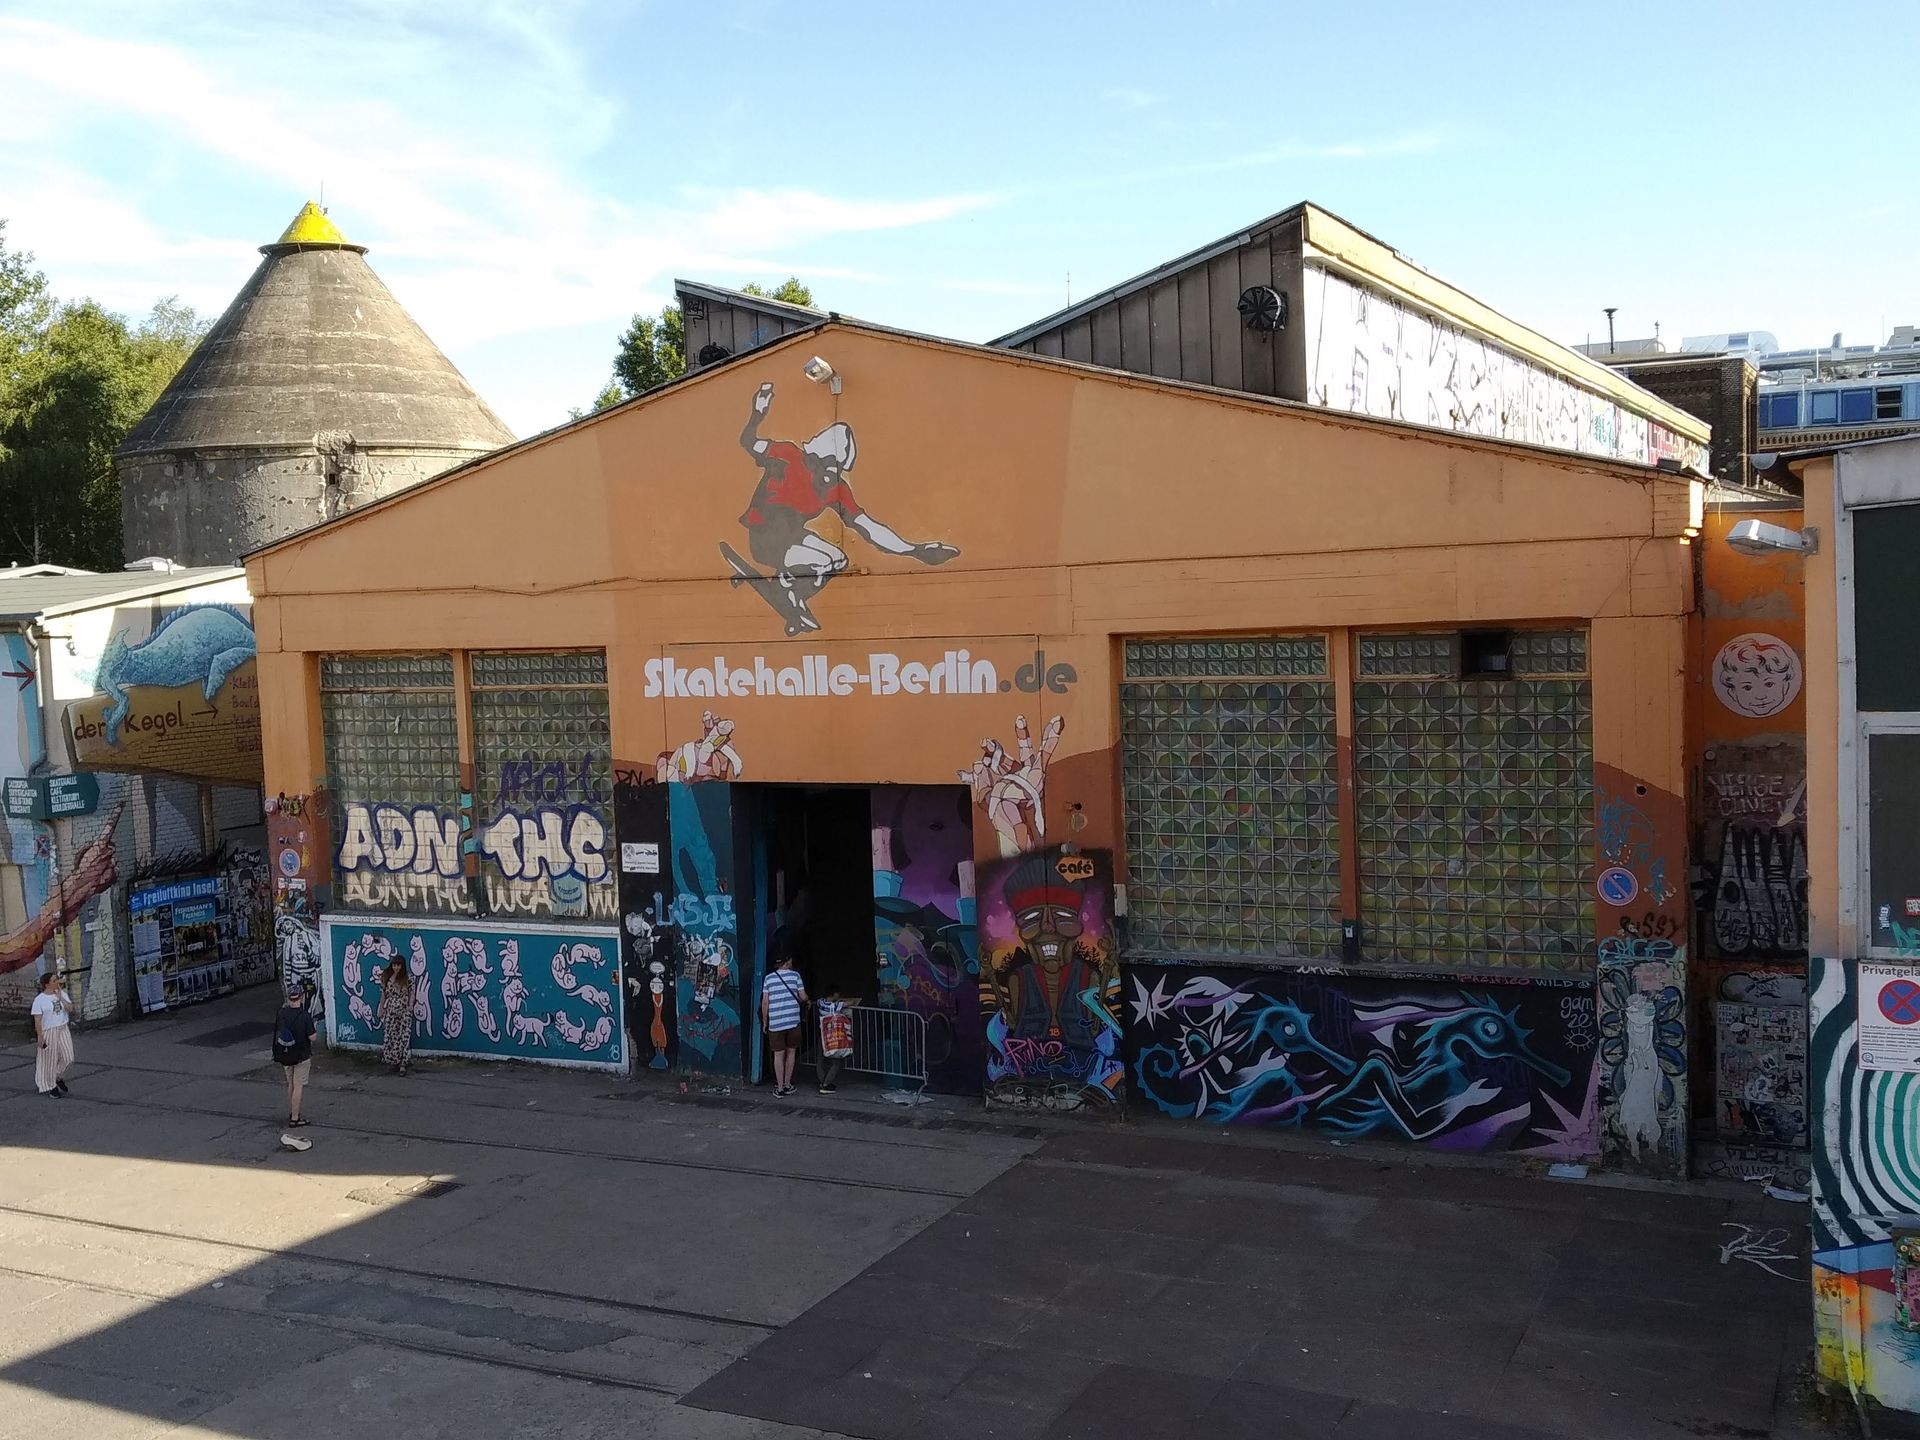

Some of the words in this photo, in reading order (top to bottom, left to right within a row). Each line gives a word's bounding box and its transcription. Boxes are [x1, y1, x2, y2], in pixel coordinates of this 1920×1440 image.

[644, 649, 1078, 698] Skatehalle-Berlin.de
[74, 714, 106, 740] der
[124, 700, 184, 736] Kegel
[339, 804, 462, 878] ADN
[481, 804, 610, 882] THC
[1058, 860, 1092, 874] café
[143, 886, 191, 905] Freiluftkino
[193, 879, 215, 895] Insel
[1535, 979, 1574, 988] WILD
